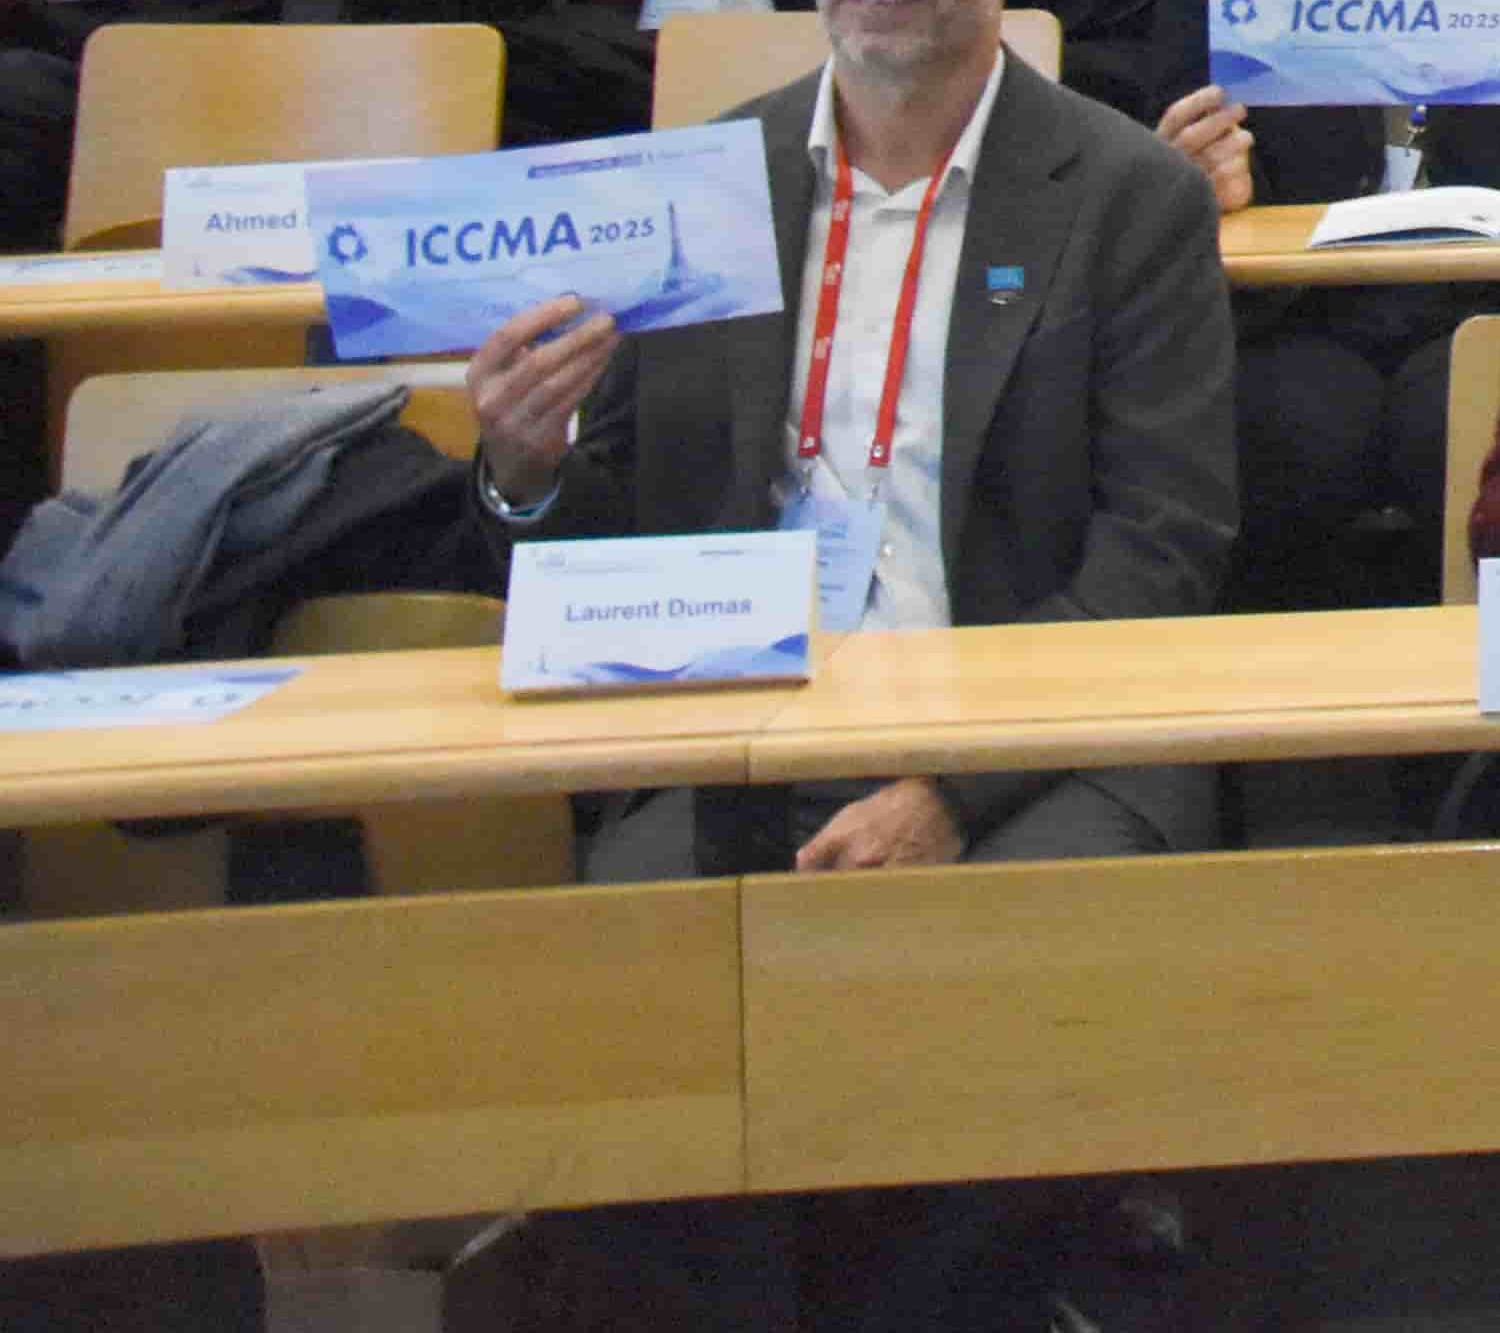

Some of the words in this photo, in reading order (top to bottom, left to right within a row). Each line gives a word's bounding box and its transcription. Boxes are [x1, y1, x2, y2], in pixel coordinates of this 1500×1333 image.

[1446, 10, 1500, 31] 2025
[205, 210, 297, 234] Ahmed
[405, 211, 582, 268] ICCMA
[589, 216, 656, 247] 2025
[565, 601, 660, 623] Laurent
[668, 598, 752, 618] Dumas
